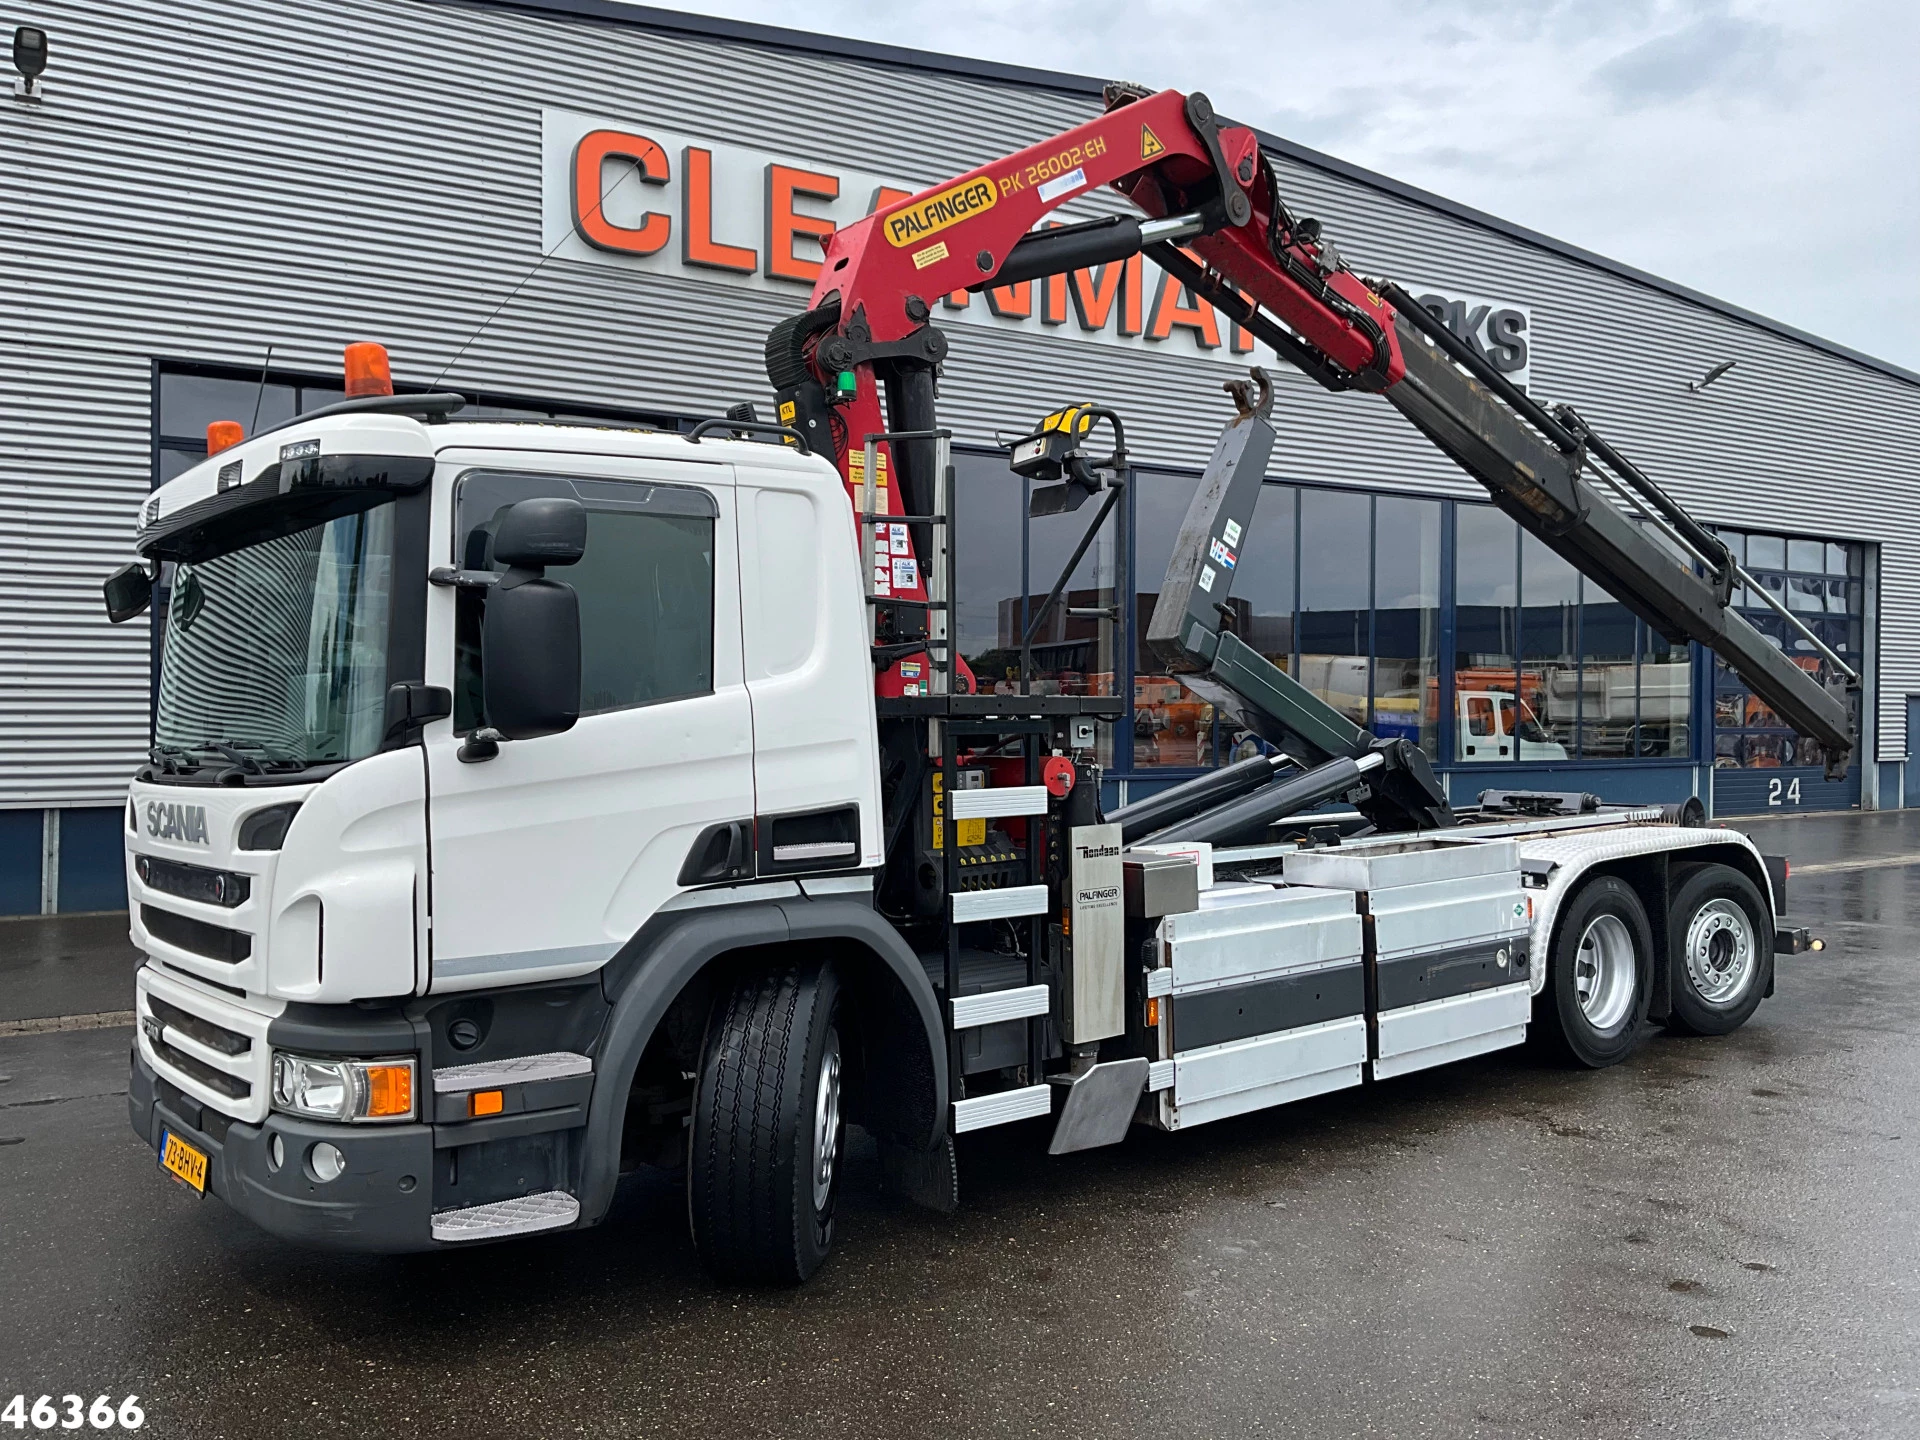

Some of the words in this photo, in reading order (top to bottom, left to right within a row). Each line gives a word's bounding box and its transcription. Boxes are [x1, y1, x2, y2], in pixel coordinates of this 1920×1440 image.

[999, 172, 1024, 197] PK
[890, 183, 992, 242] PALFINGER
[1769, 777, 1801, 806] 24
[147, 800, 210, 845] SCANIA
[1079, 888, 1118, 901] PALFINGER
[166, 1138, 203, 1184] 73-BHV-4
